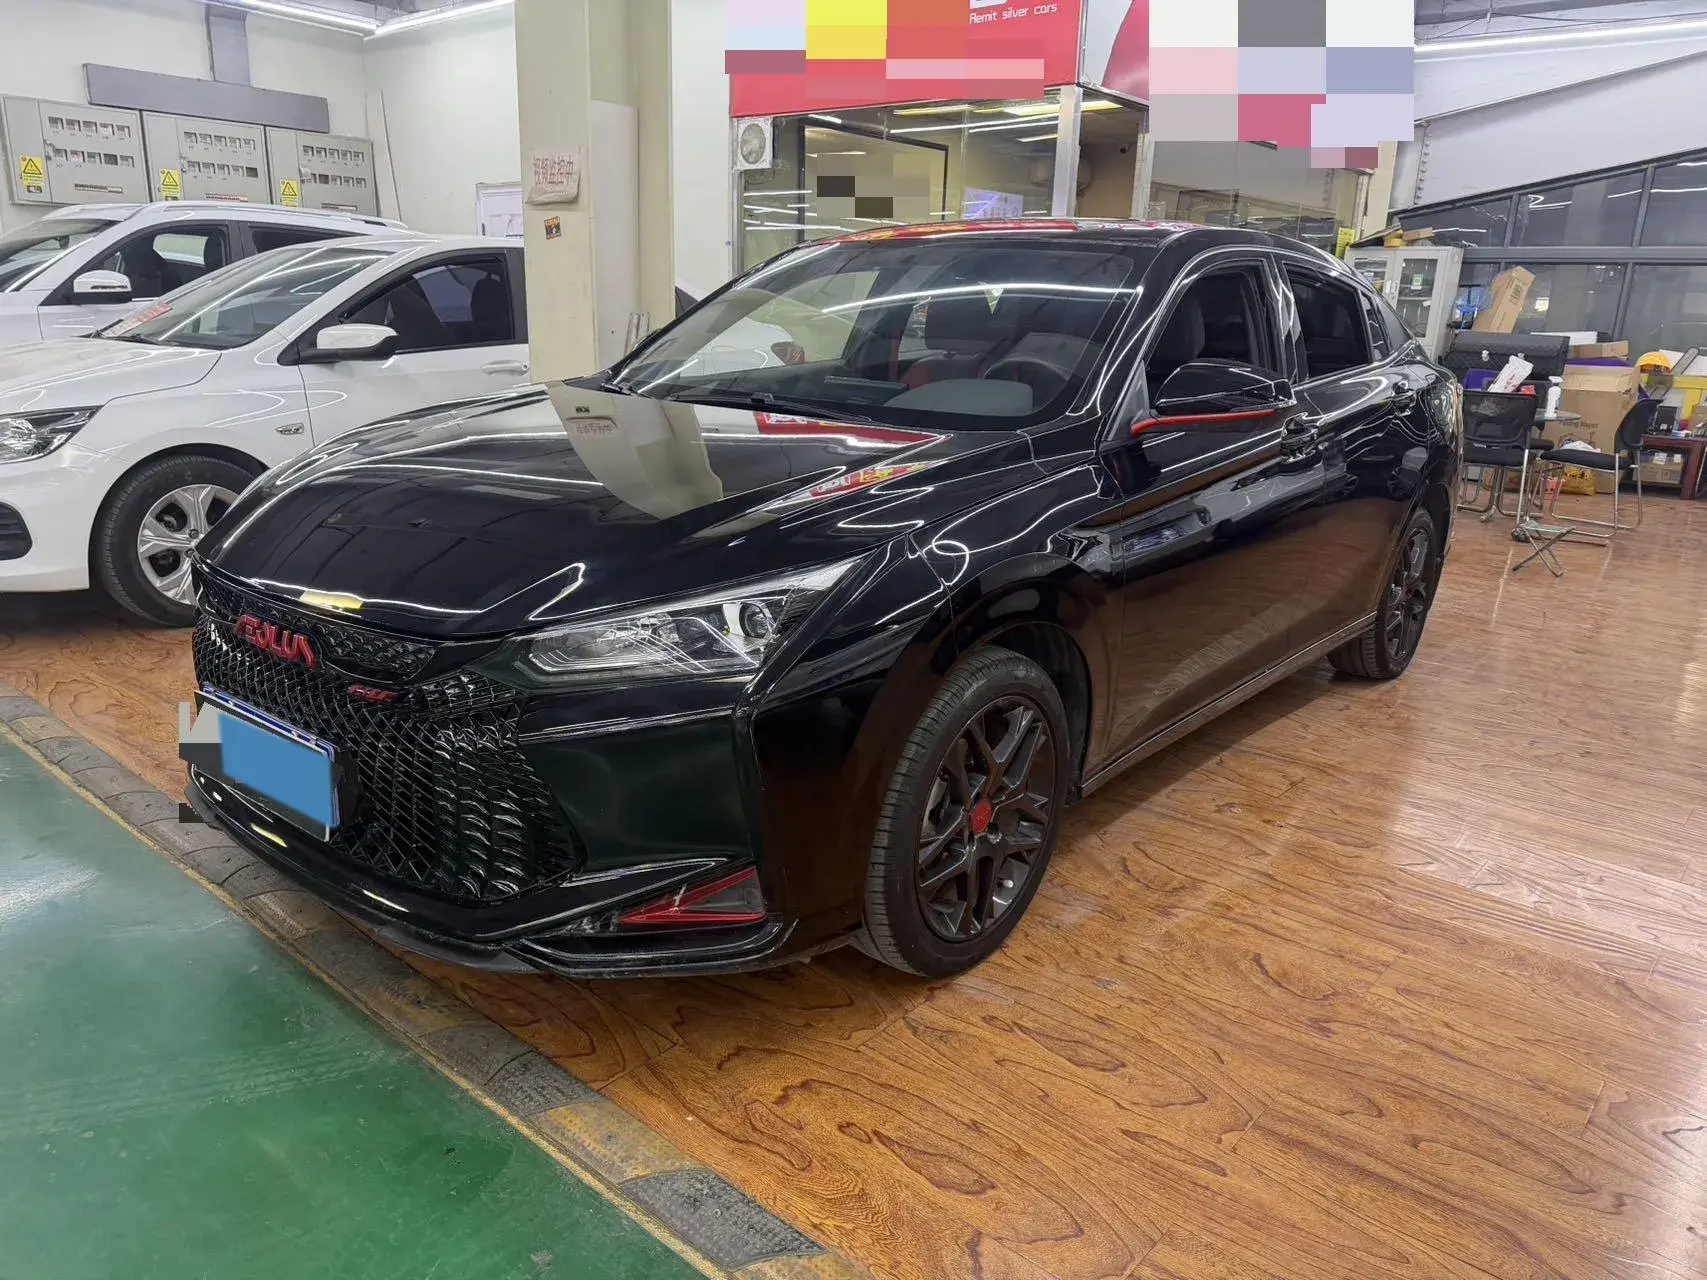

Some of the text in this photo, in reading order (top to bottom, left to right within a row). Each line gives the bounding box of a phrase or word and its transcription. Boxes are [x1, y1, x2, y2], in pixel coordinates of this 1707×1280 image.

[969, 3, 1058, 24] Remit silver cars
